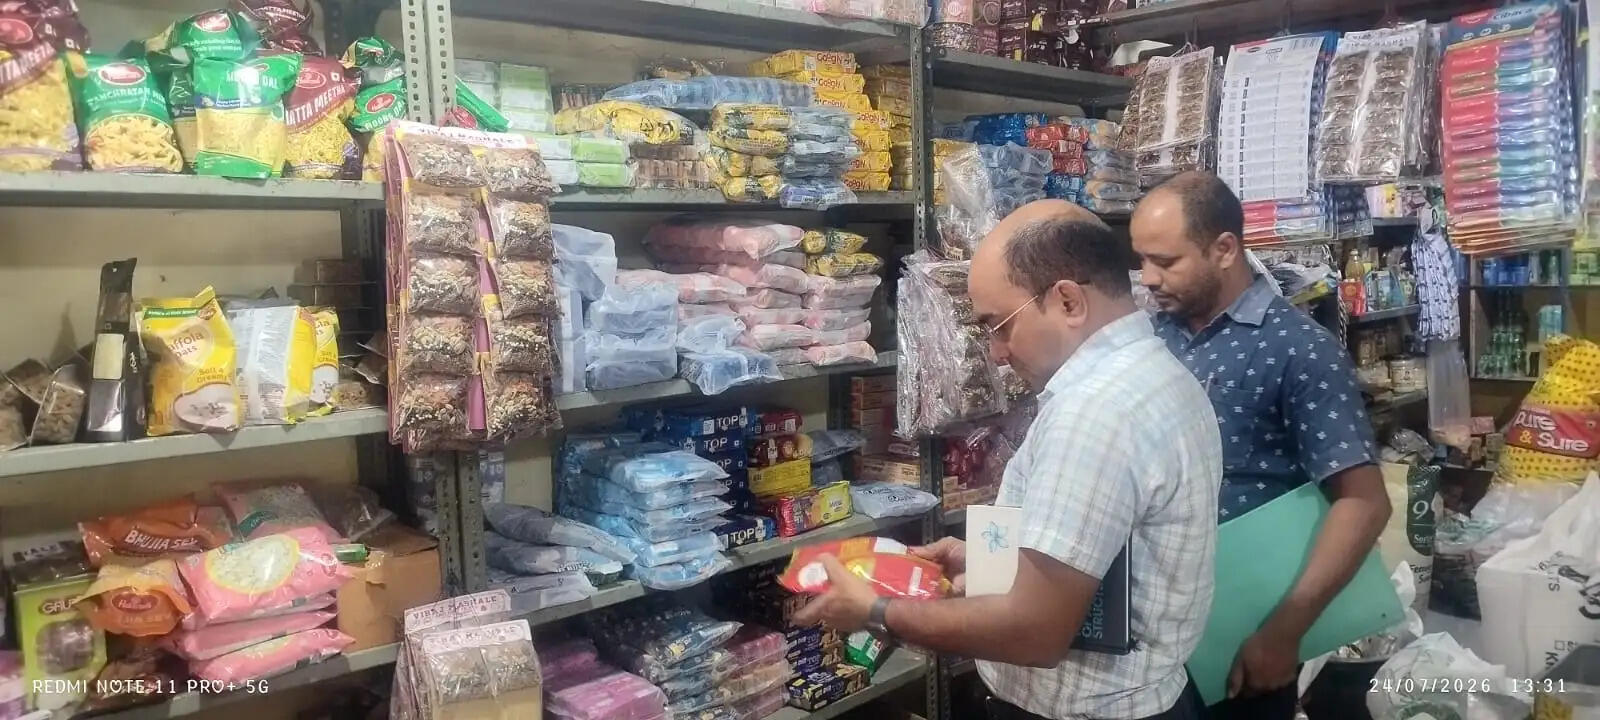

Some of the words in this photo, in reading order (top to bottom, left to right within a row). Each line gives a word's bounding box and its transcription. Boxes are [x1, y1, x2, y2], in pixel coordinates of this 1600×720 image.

[167, 331, 204, 352] affola
[717, 415, 739, 426] TOP
[1514, 411, 1556, 431] Pure
[704, 437, 728, 450] TOP
[1520, 429, 1532, 445] &
[1537, 432, 1589, 452] Sure
[719, 458, 732, 470] OP
[125, 529, 168, 550] BHUJIA
[731, 527, 755, 542] TOP
[413, 606, 444, 620] VIRAJ
